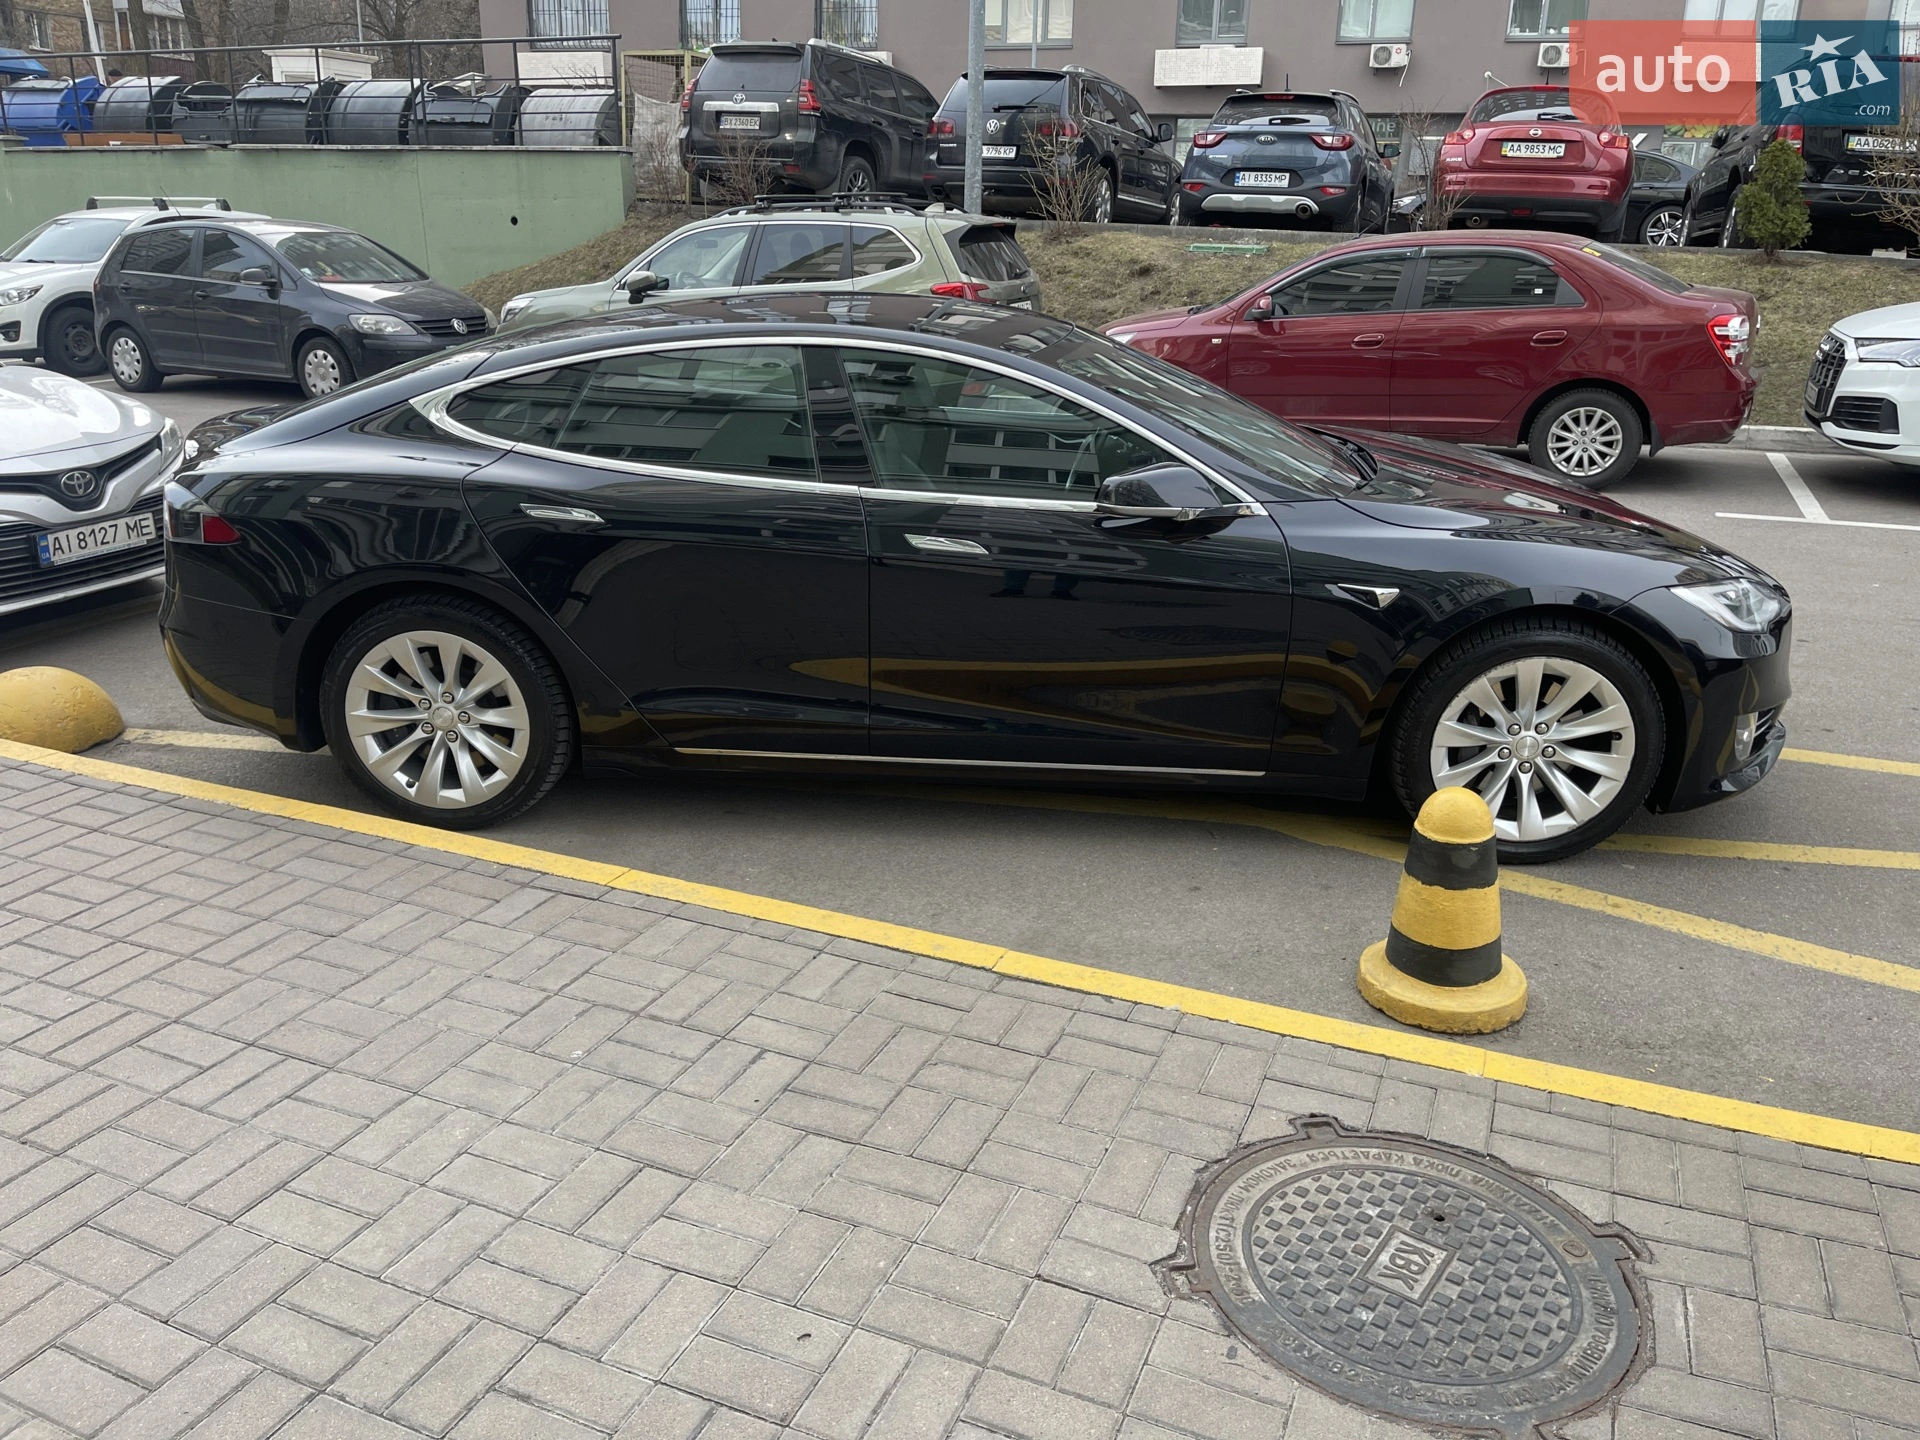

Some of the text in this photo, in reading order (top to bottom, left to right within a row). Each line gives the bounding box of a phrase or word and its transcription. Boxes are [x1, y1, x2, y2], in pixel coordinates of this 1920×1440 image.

[1855, 138, 1870, 148] AA
[985, 146, 1014, 156] 9796 KP
[1508, 144, 1563, 155] AA 9853 MC
[1240, 172, 1287, 183] AI 8335 MP
[52, 533, 72, 557] AI
[76, 523, 118, 550] 8127
[125, 517, 152, 540] ME
[1377, 1240, 1435, 1291] КВК
